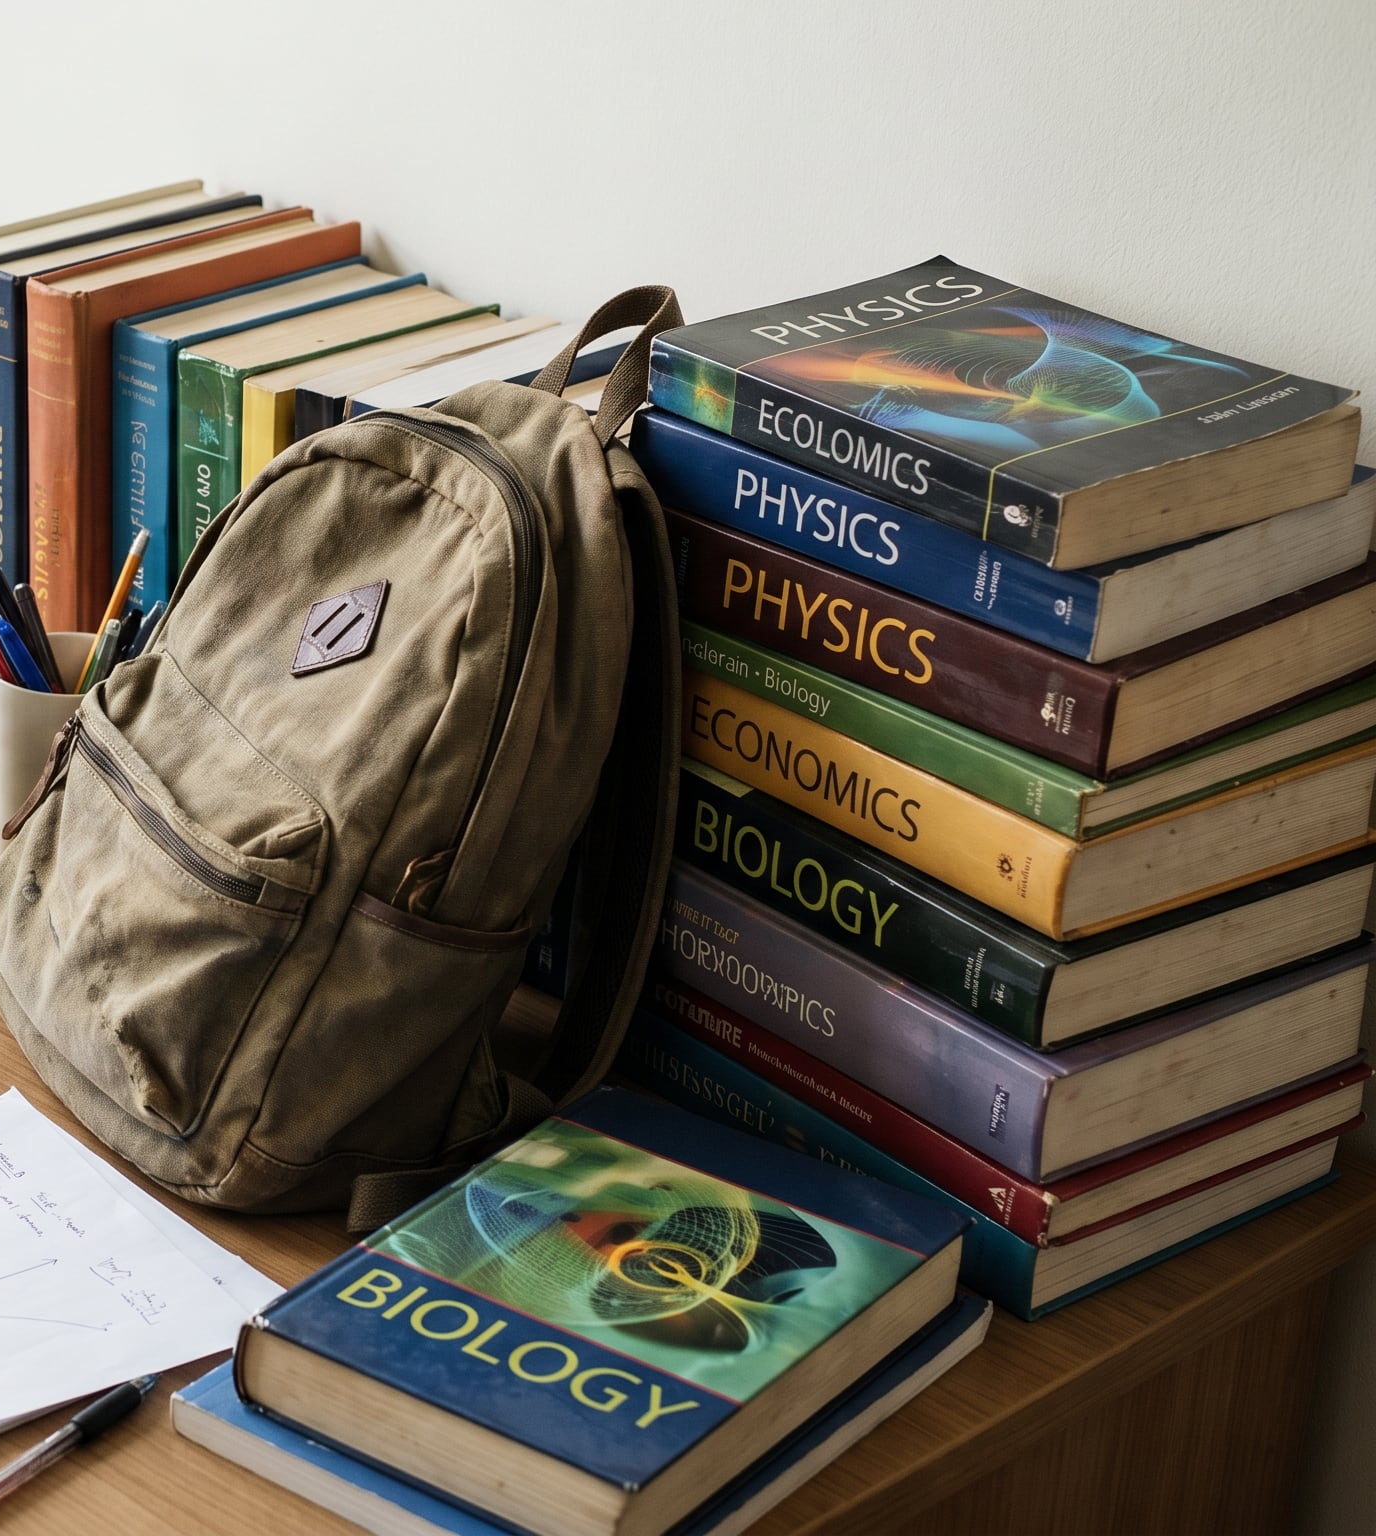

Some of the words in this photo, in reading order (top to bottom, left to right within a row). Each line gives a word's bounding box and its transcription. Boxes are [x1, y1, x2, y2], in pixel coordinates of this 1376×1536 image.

[750, 276, 983, 345] PHYSICS
[758, 398, 931, 495] ECOLOMICS
[735, 469, 900, 566] PHYSICS
[723, 558, 936, 685] PHYSICS
[764, 666, 831, 717] Biology
[690, 694, 920, 842] ECONOMICS
[694, 800, 899, 947] BIOLOGY
[336, 1269, 698, 1428] BIOLOGY
